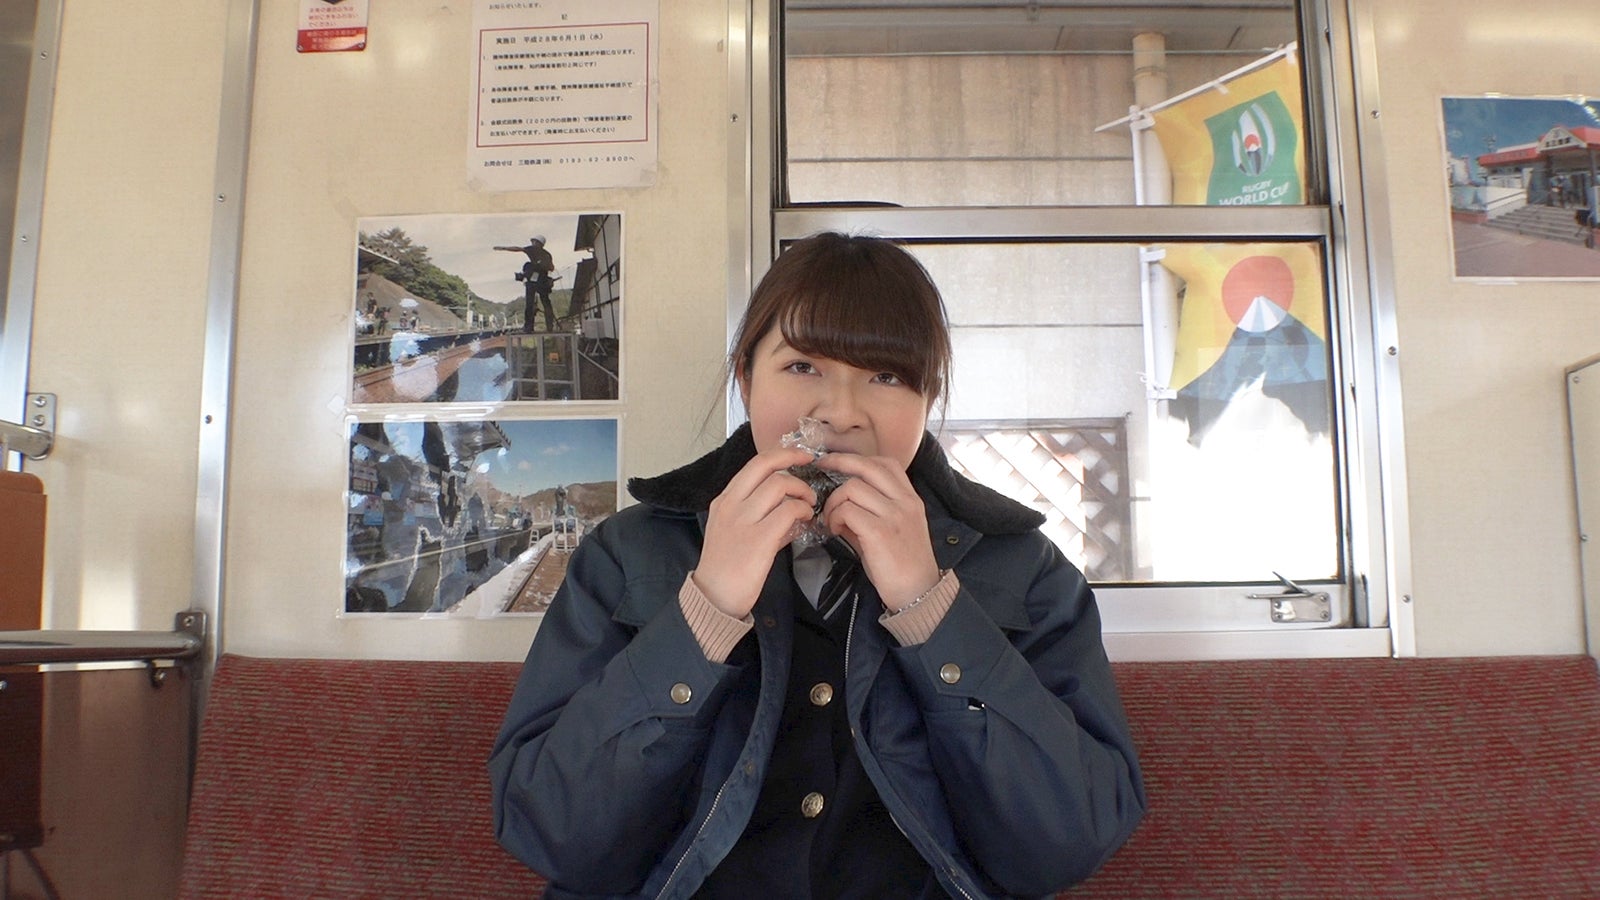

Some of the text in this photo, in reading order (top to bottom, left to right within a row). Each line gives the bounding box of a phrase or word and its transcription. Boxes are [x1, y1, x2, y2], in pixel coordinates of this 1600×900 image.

[496, 37, 517, 45] 実施日
[1242, 179, 1272, 193] RUGBY
[1218, 191, 1268, 205] WORLD
